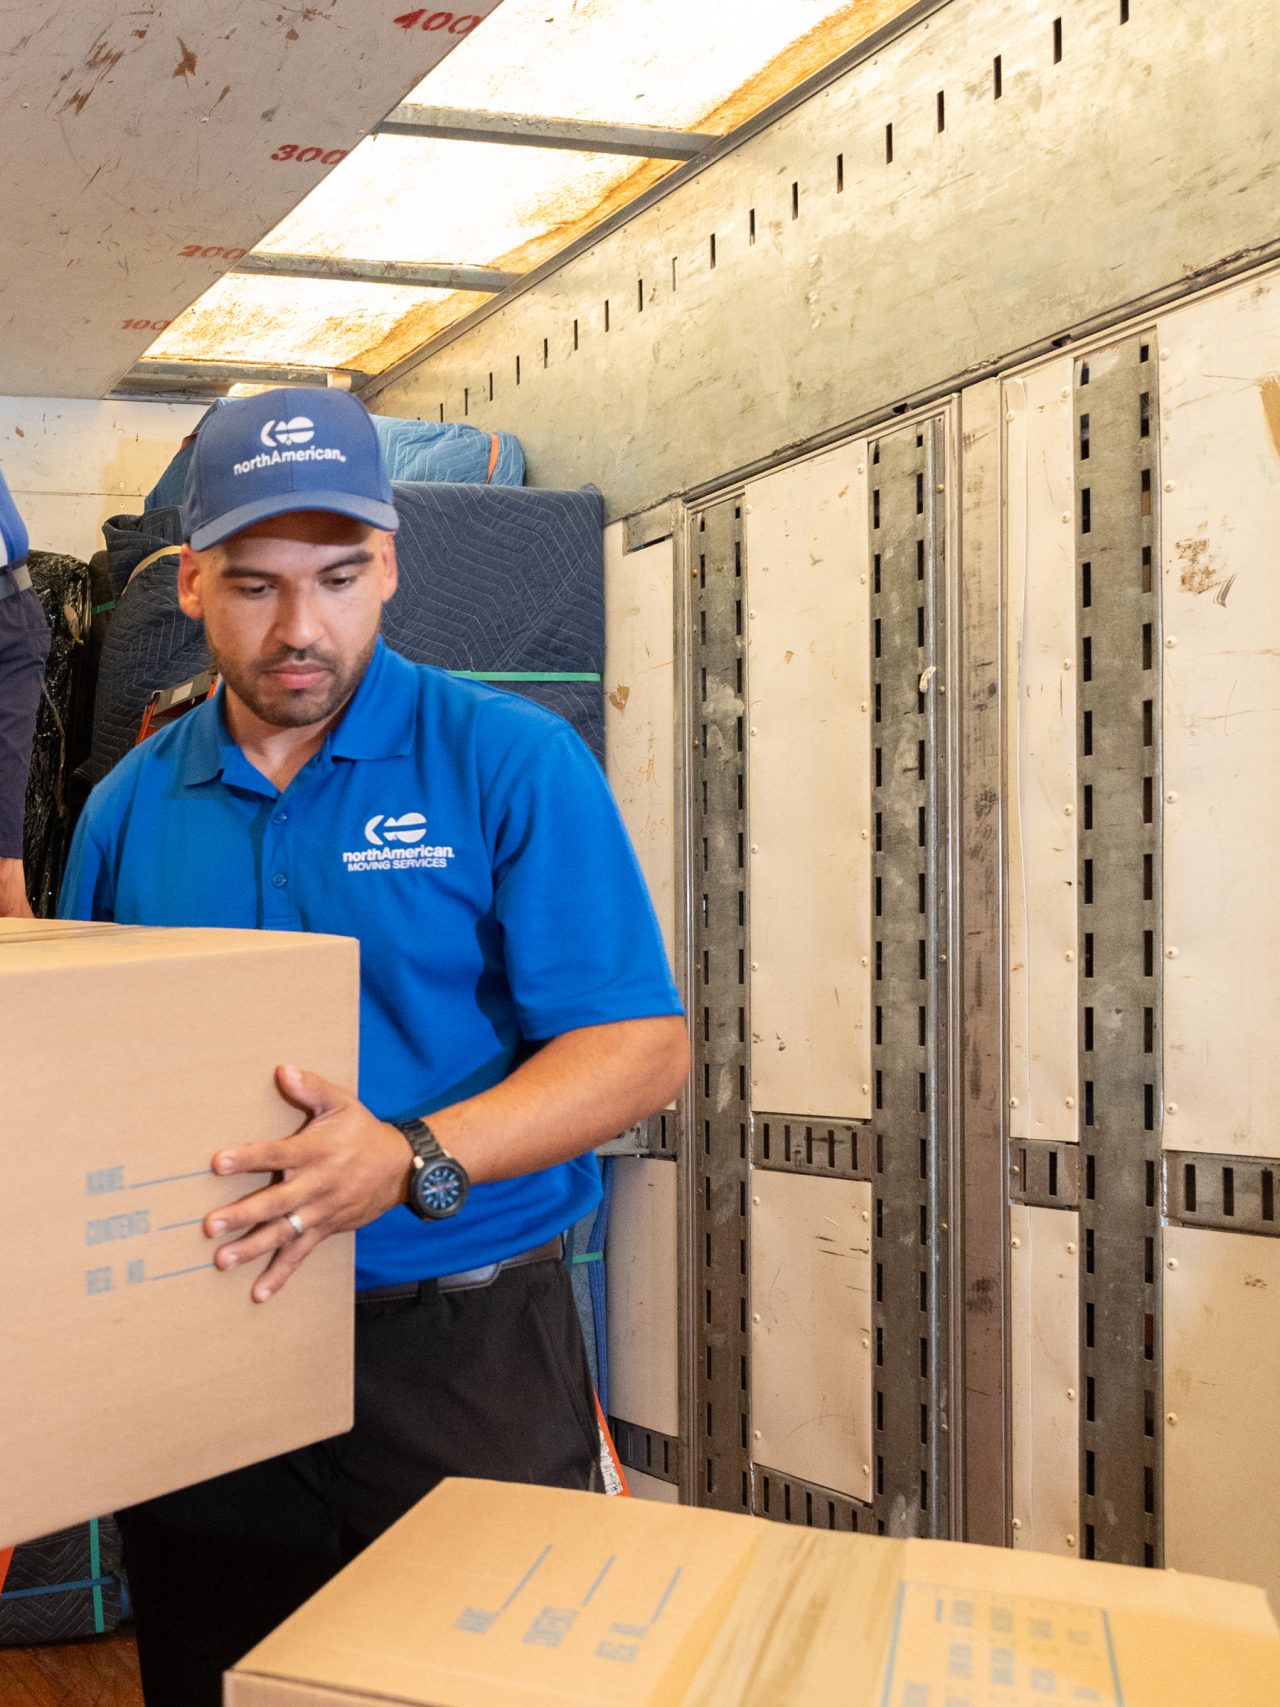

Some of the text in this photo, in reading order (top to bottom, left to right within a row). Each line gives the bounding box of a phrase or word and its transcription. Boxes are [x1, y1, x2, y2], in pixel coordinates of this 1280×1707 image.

[393, 8, 482, 35] 400
[271, 144, 349, 165] 300
[176, 245, 248, 260] 200
[121, 318, 173, 331] 100
[232, 445, 346, 476] northAmerican
[342, 844, 453, 863] northAmerican
[347, 860, 391, 873] MOVING
[392, 857, 447, 869] SERVICES
